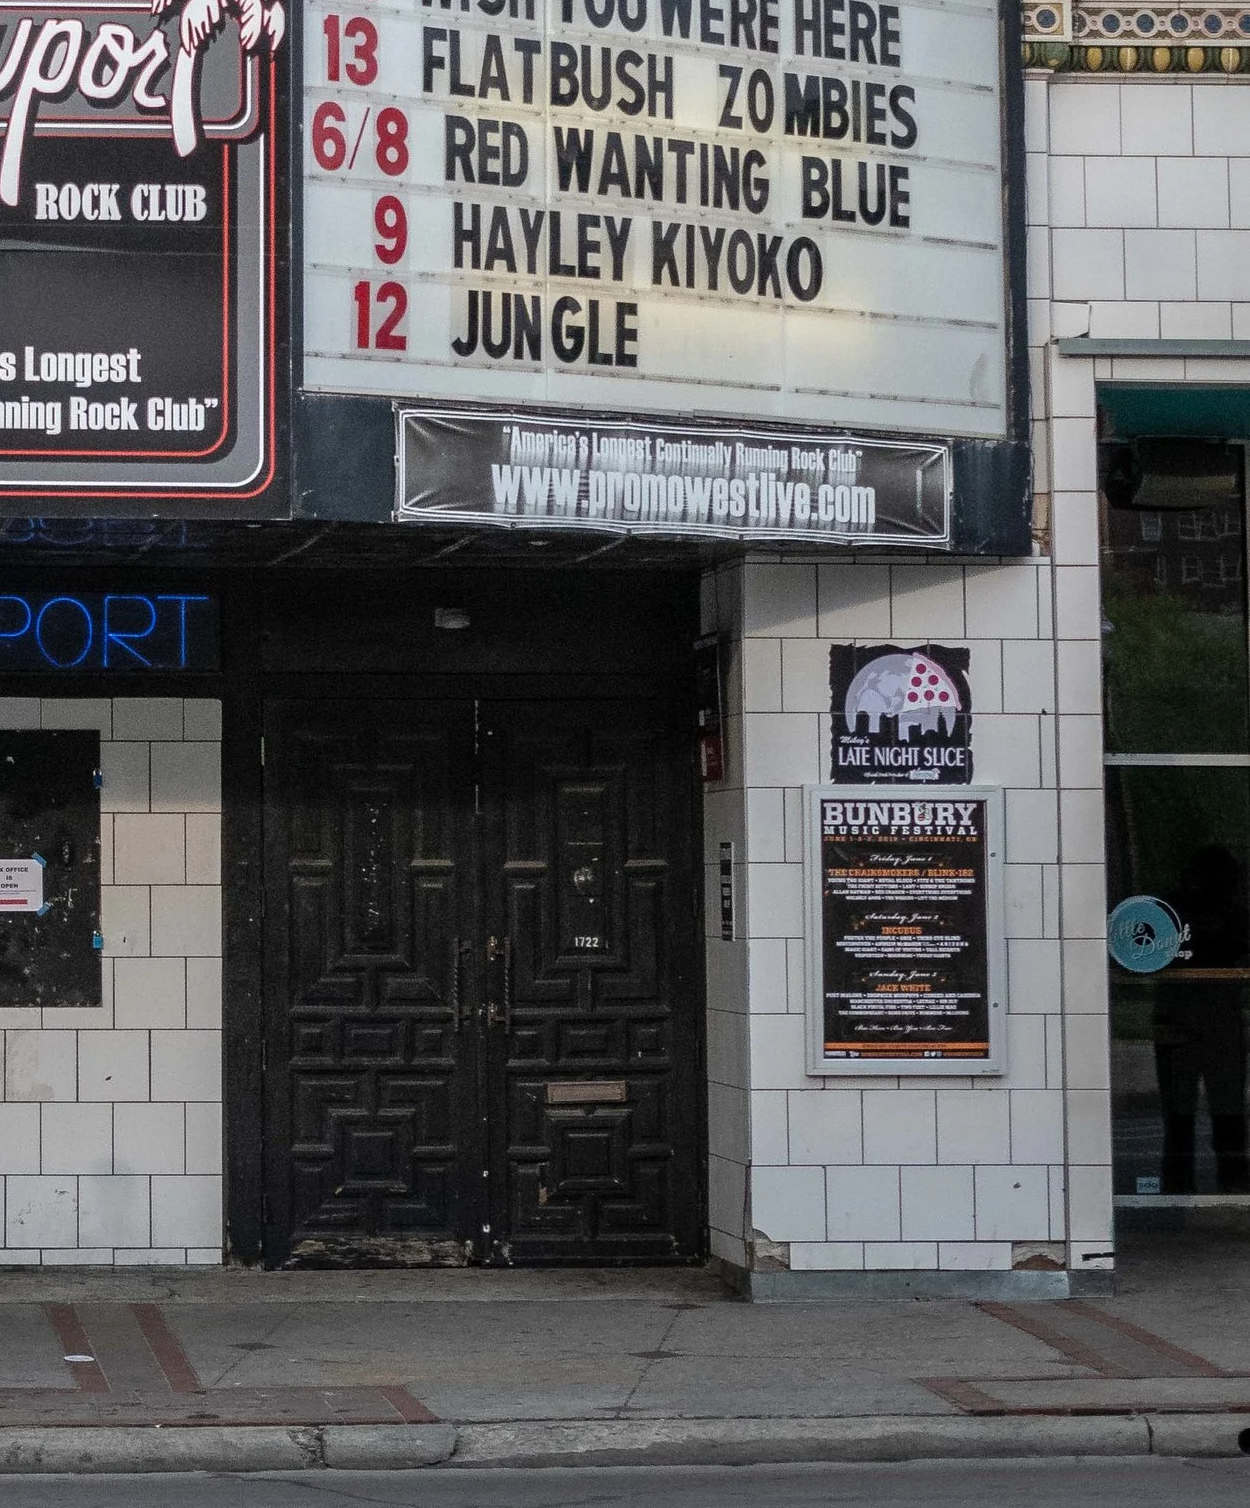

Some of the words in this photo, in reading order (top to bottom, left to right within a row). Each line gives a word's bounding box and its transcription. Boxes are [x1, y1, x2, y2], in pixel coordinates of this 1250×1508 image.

[323, 14, 379, 87] 13
[422, 25, 675, 120] FLATBUSH
[717, 64, 919, 150] ZOMBIES
[311, 101, 410, 177] 6/8
[444, 113, 529, 188] RED
[554, 125, 771, 215] WANTING
[801, 155, 911, 230] BLUE
[35, 183, 123, 221] ROCK
[130, 184, 208, 222] CLUB
[373, 195, 409, 265] 9
[452, 201, 633, 283] HAYLEY
[651, 220, 824, 303] KIYOKO
[353, 281, 409, 352] 12
[451, 289, 639, 369] JUNGLE
[24, 347, 142, 388] Longest
[69, 397, 140, 431] Rock
[592, 432, 652, 465] Longest
[655, 438, 733, 469] Continually
[734, 444, 789, 472] Running
[791, 447, 825, 472] Rock
[491, 462, 876, 524] www.promowestlive.com
[838, 746, 870, 766] LATE
[874, 746, 920, 767] NIGHT
[923, 746, 965, 767] SLICE
[823, 802, 978, 826] BUNBURY
[823, 826, 880, 835] MUSIC
[890, 826, 978, 835] FESTIVAL
[828, 868, 848, 877] THE
[574, 936, 599, 948] 1722
[881, 926, 922, 935] INCUBUS
[875, 984, 900, 992] JACK
[900, 984, 931, 992] WHITE
